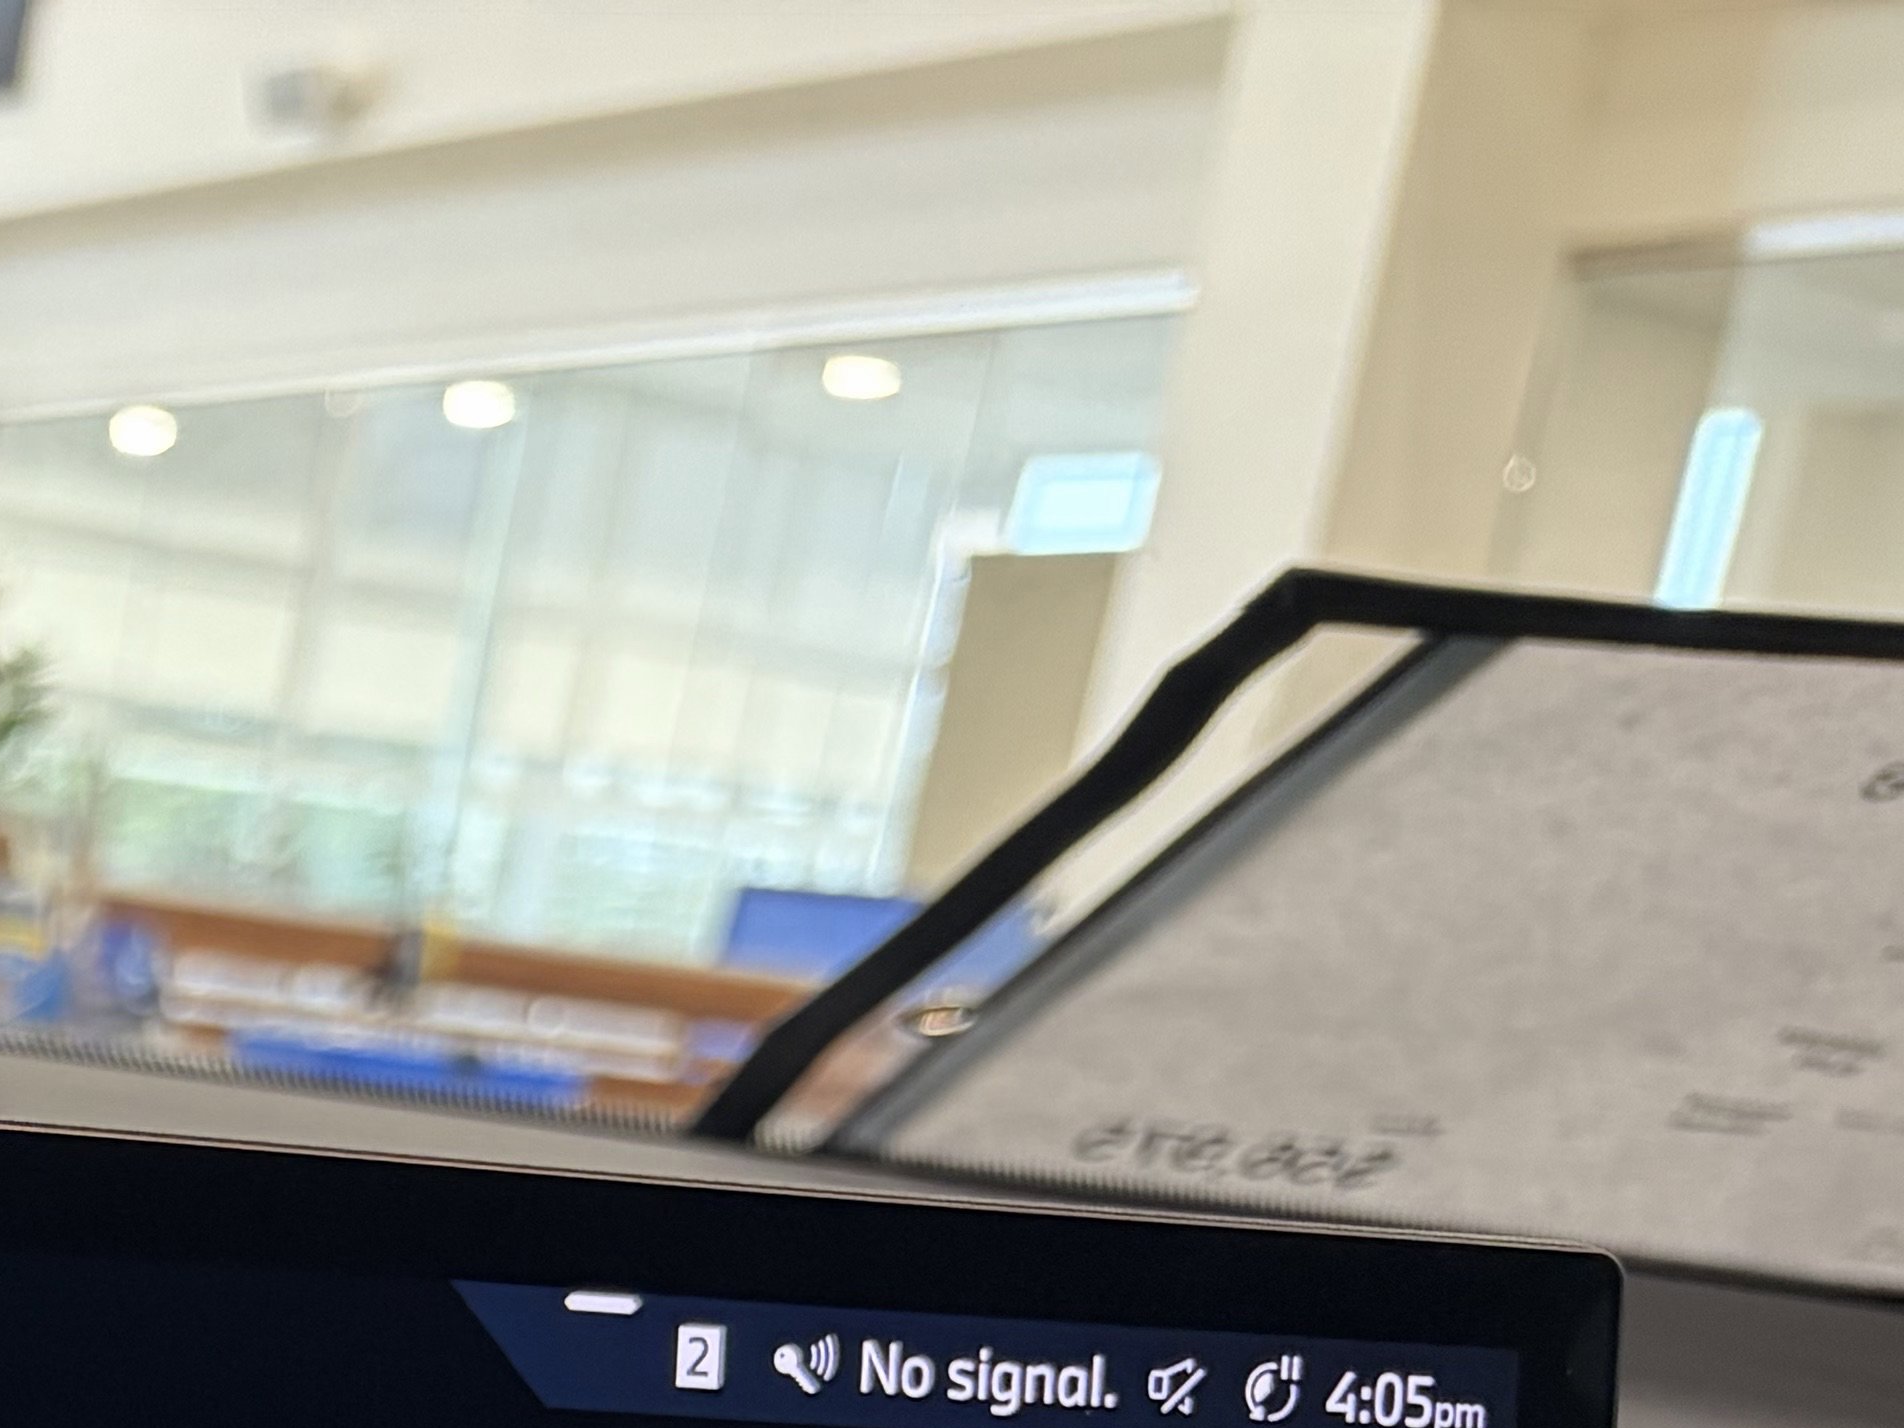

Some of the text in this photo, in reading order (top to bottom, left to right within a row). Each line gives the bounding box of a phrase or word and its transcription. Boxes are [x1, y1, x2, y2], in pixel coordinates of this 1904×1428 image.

[684, 1334, 713, 1380] 2
[858, 1338, 1119, 1418] No signal.
